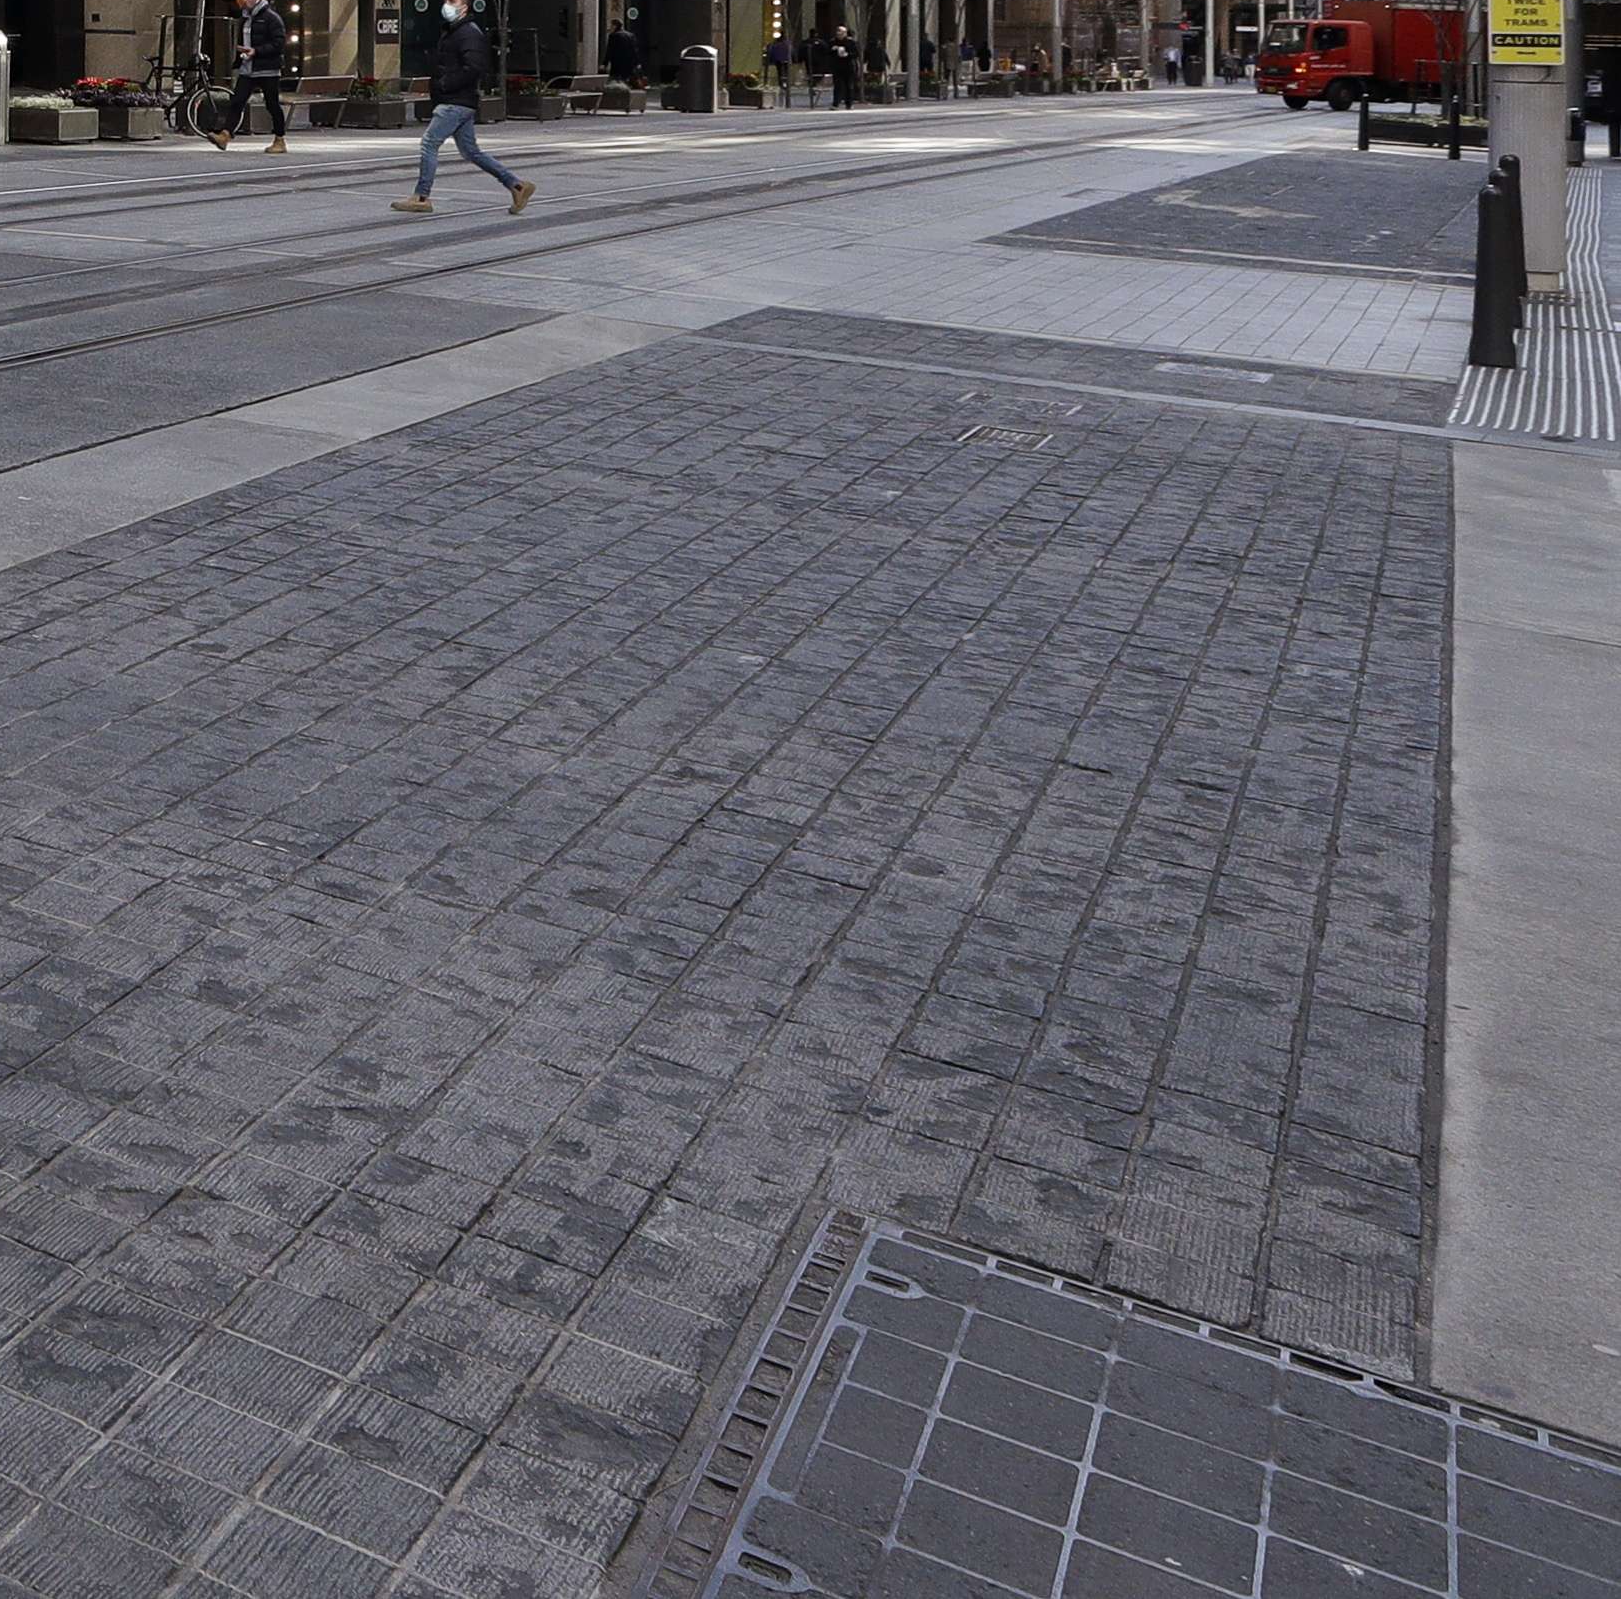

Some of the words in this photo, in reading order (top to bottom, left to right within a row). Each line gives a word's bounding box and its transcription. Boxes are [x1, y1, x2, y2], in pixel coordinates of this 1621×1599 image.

[1514, 8, 1538, 16] FOR
[1505, 18, 1548, 27] TRAMS
[1494, 36, 1559, 45] CAUTION
